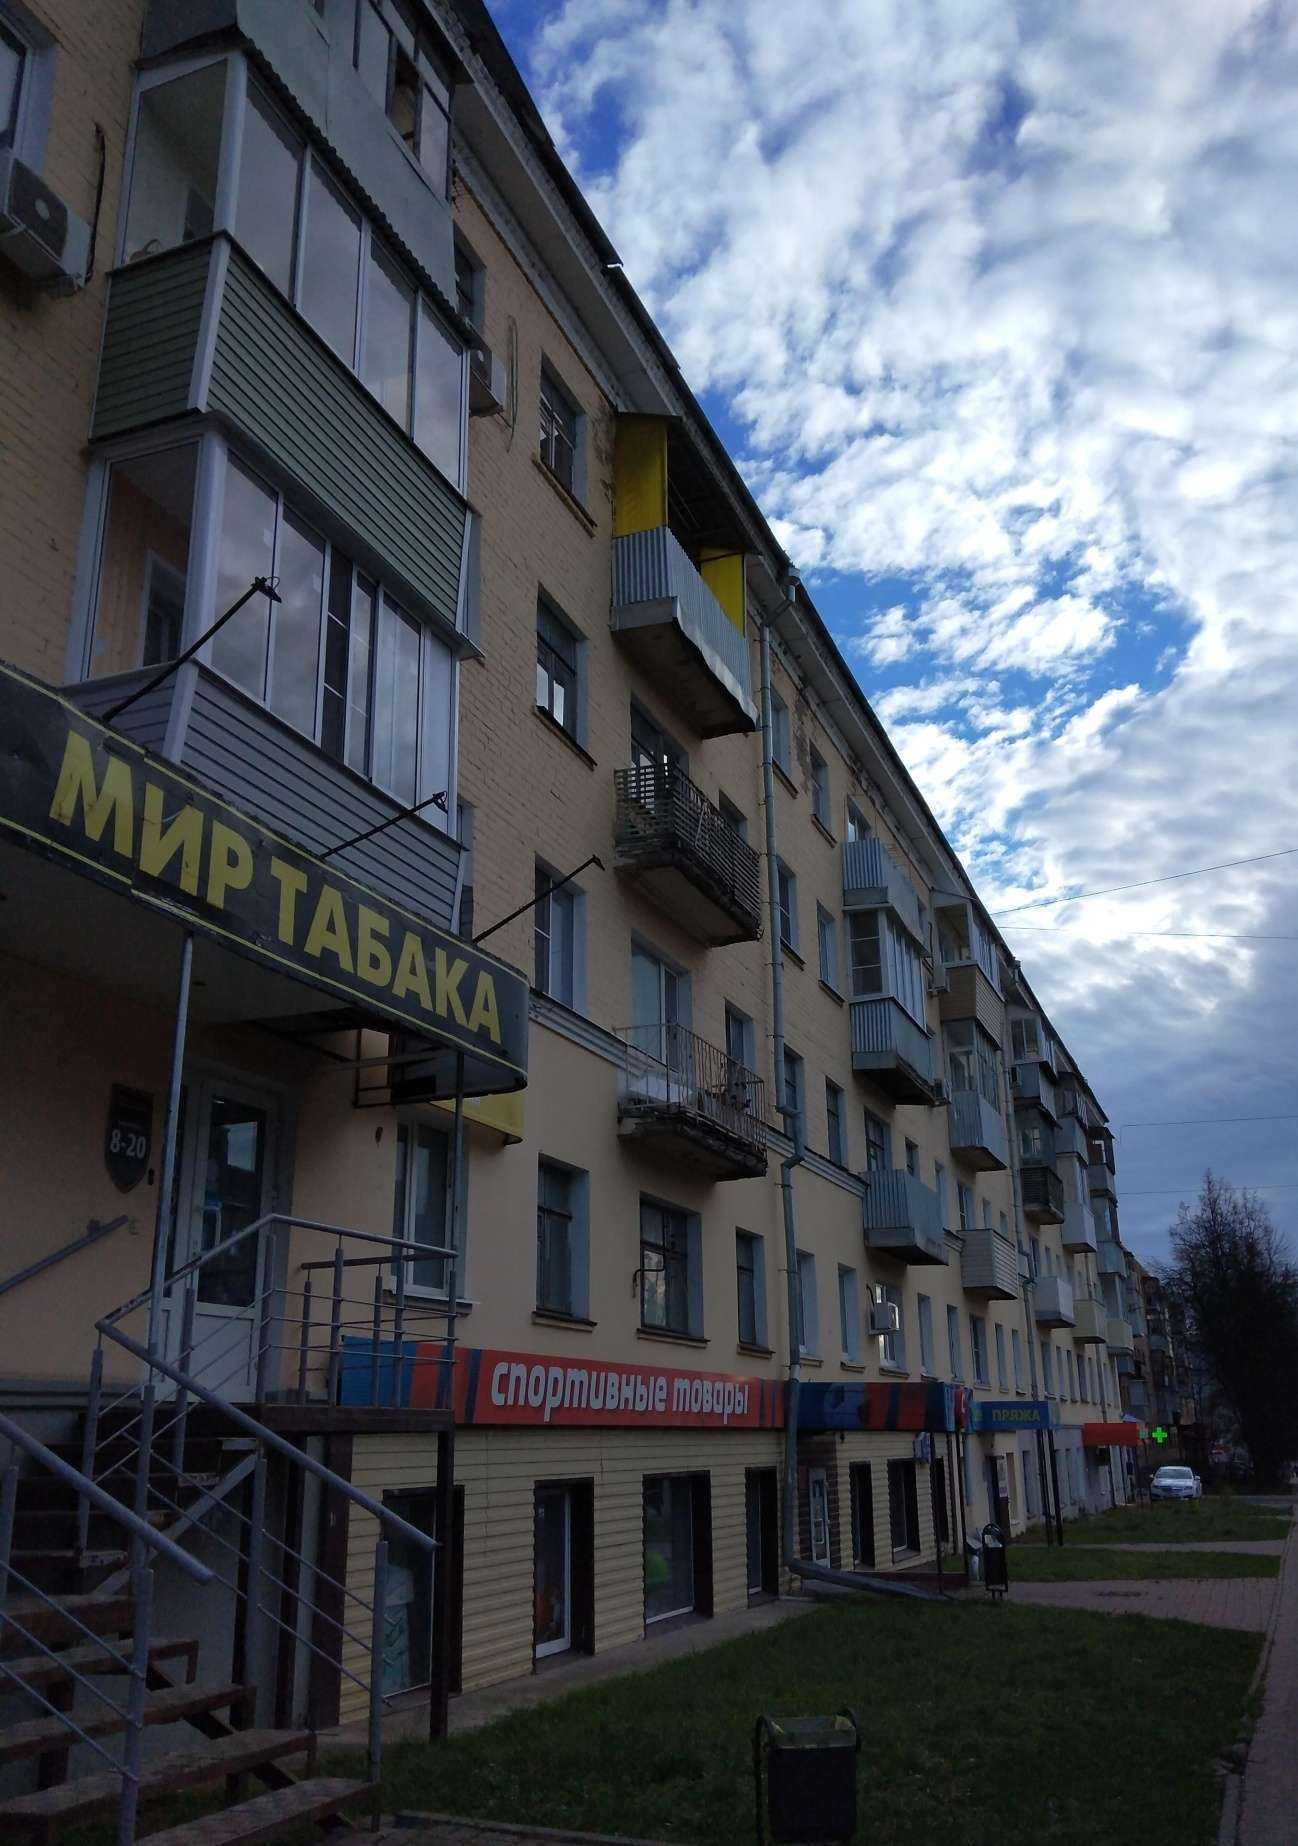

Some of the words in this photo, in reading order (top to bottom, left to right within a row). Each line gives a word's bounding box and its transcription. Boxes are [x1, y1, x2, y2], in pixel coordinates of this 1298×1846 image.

[49, 730, 253, 910] МИР
[271, 856, 502, 1043] ТАБАКА
[110, 1129, 146, 1159] 8-20
[491, 1361, 667, 1422] спортивные
[672, 1378, 749, 1424] товары
